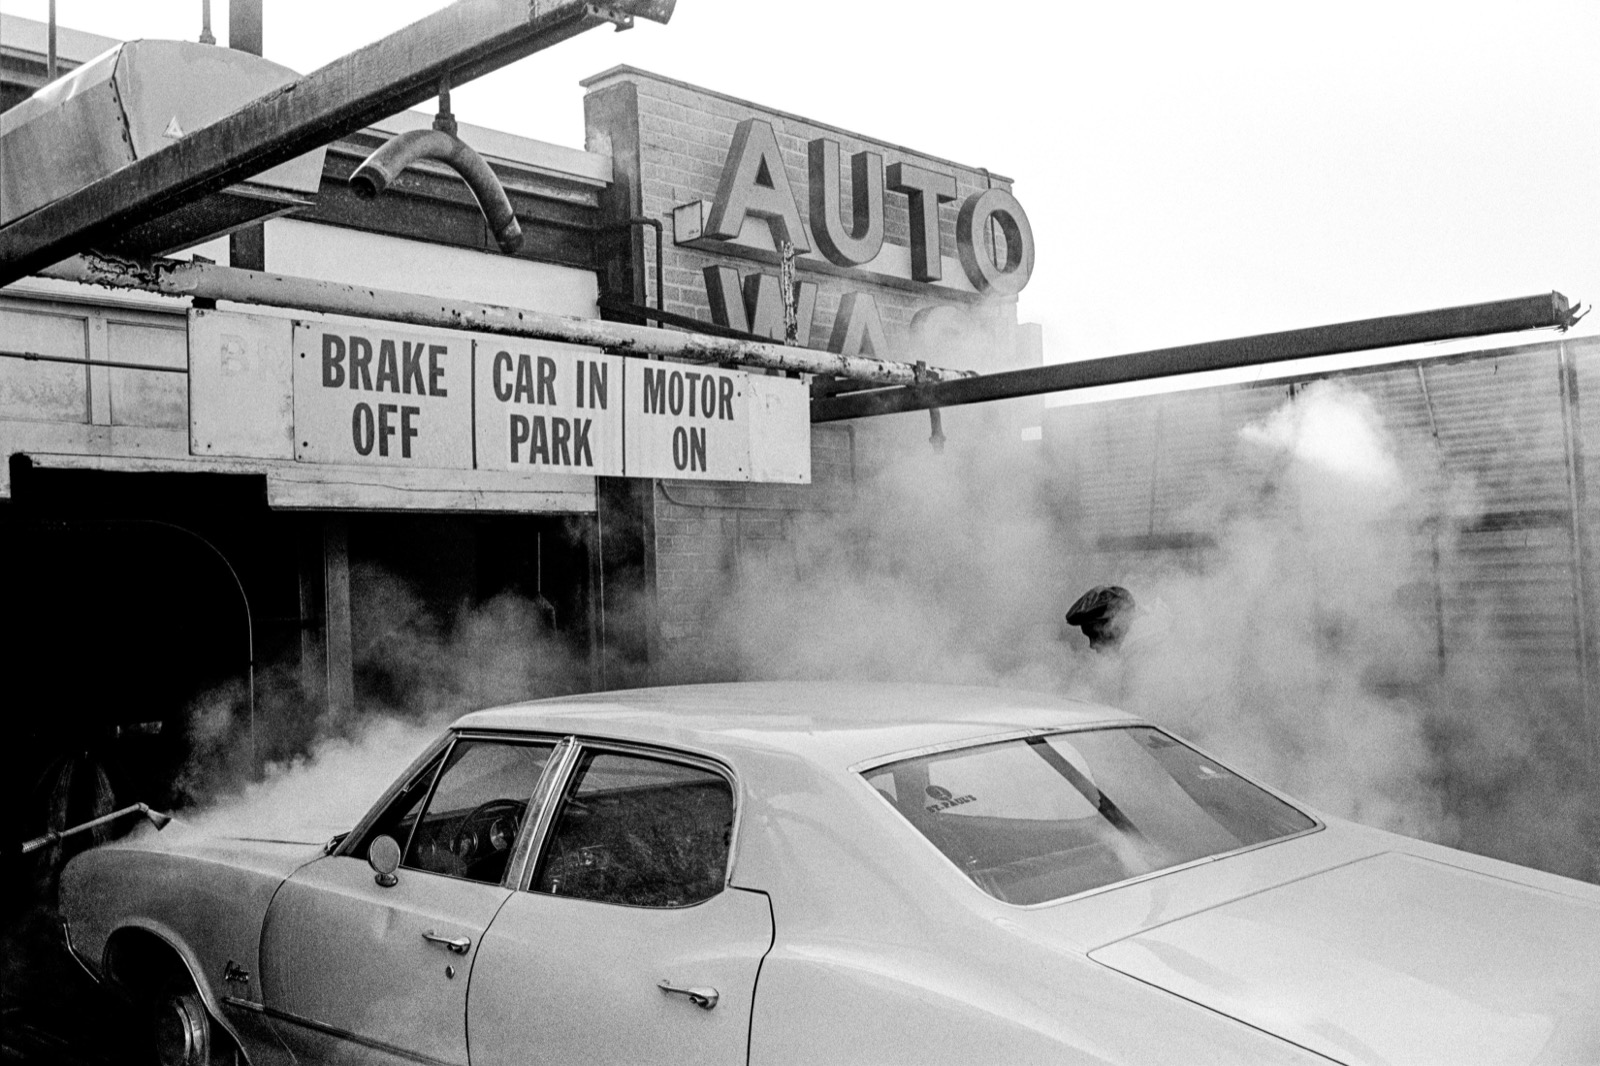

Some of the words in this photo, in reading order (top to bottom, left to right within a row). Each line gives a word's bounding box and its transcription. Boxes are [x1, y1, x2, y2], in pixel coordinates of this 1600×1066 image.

[703, 117, 1035, 297] AUTO
[322, 333, 448, 397] BRAKE
[493, 351, 557, 406] CAR
[577, 360, 608, 410] IN
[644, 367, 734, 421] MOTOR
[352, 402, 420, 458] OFF
[510, 414, 593, 467] PARK
[673, 426, 707, 472] ON
